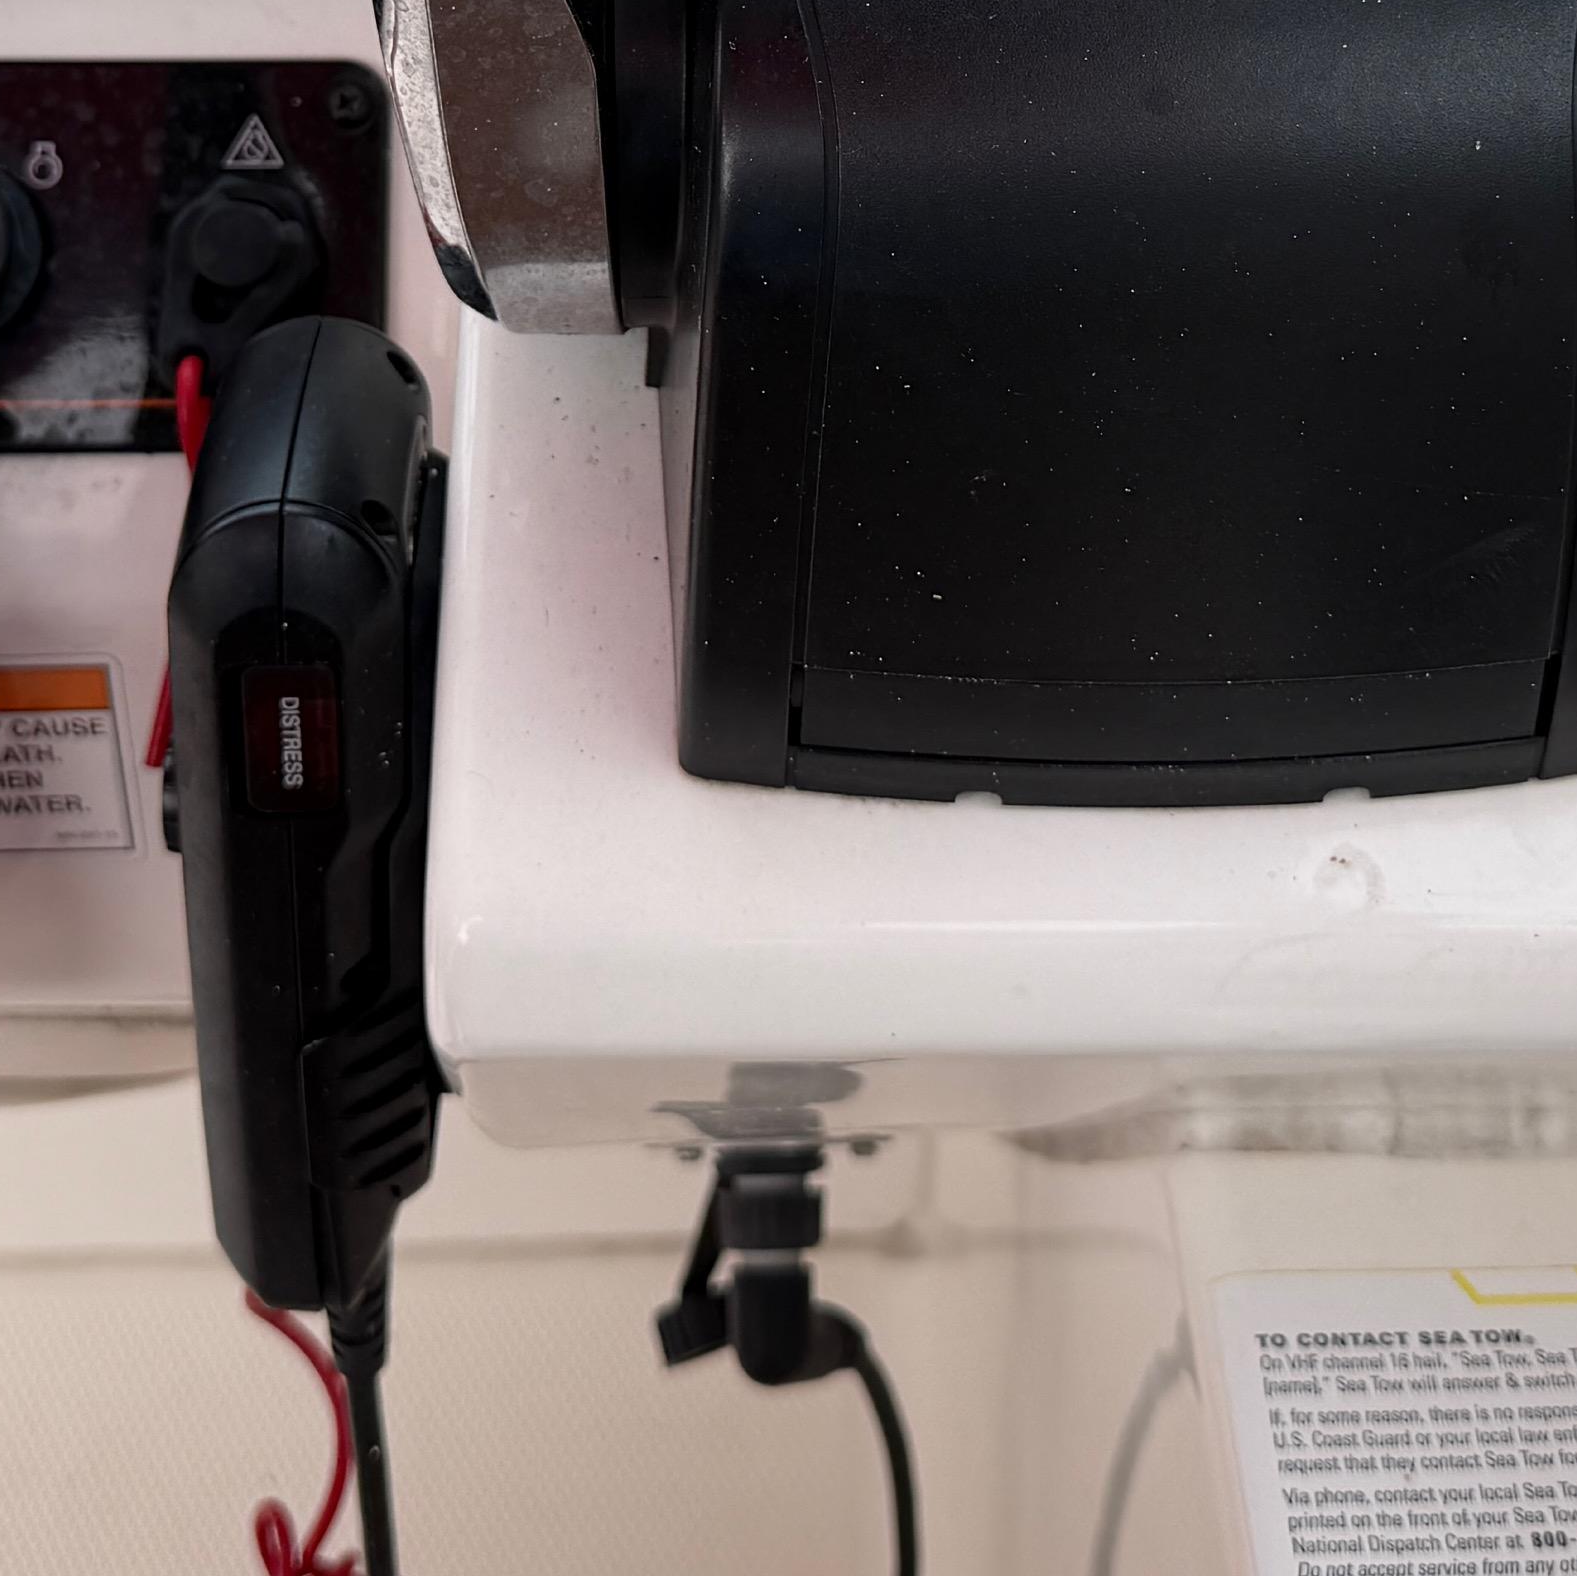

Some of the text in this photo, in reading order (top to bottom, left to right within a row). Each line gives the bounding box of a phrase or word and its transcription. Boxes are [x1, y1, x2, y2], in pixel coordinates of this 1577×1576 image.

[12, 717, 108, 737] CAUSE
[281, 697, 304, 790] DISTRESS
[1253, 1332, 1290, 1352] TO
[1295, 1330, 1410, 1351] CONTACT
[1416, 1329, 1469, 1348] SEA
[1288, 1407, 1315, 1428] for
[1316, 1409, 1362, 1427] some
[1427, 1405, 1473, 1425] there
[1473, 1403, 1492, 1424] is
[1491, 1406, 1515, 1423] no
[1310, 1429, 1361, 1450] Coast
[1360, 1428, 1414, 1450] Guard
[1414, 1431, 1433, 1448] or
[1434, 1431, 1473, 1448] your
[1474, 1426, 1518, 1447] local
[1516, 1425, 1551, 1446] law
[1280, 1486, 1313, 1508] Via
[1373, 1486, 1438, 1505] contact
[1437, 1486, 1477, 1504] your
[1477, 1481, 1522, 1503] local
[1521, 1481, 1559, 1502] Sea
[1286, 1510, 1349, 1532] printed
[1349, 1513, 1375, 1530] on
[1374, 1509, 1405, 1529] the
[1405, 1508, 1450, 1529] front
[1450, 1507, 1472, 1528] of
[1470, 1510, 1510, 1527] your
[1511, 1505, 1549, 1526] Sea
[1290, 1533, 1366, 1557] National
[1366, 1532, 1444, 1555] Dispatch
[1443, 1529, 1502, 1553] Center
[1504, 1533, 1525, 1551] at
[1297, 1560, 1322, 1575] Do
[1325, 1561, 1354, 1575] not
[1357, 1560, 1414, 1575] accept
[1417, 1557, 1479, 1575] service
[1481, 1556, 1522, 1574] from
[1524, 1558, 1556, 1574] any
